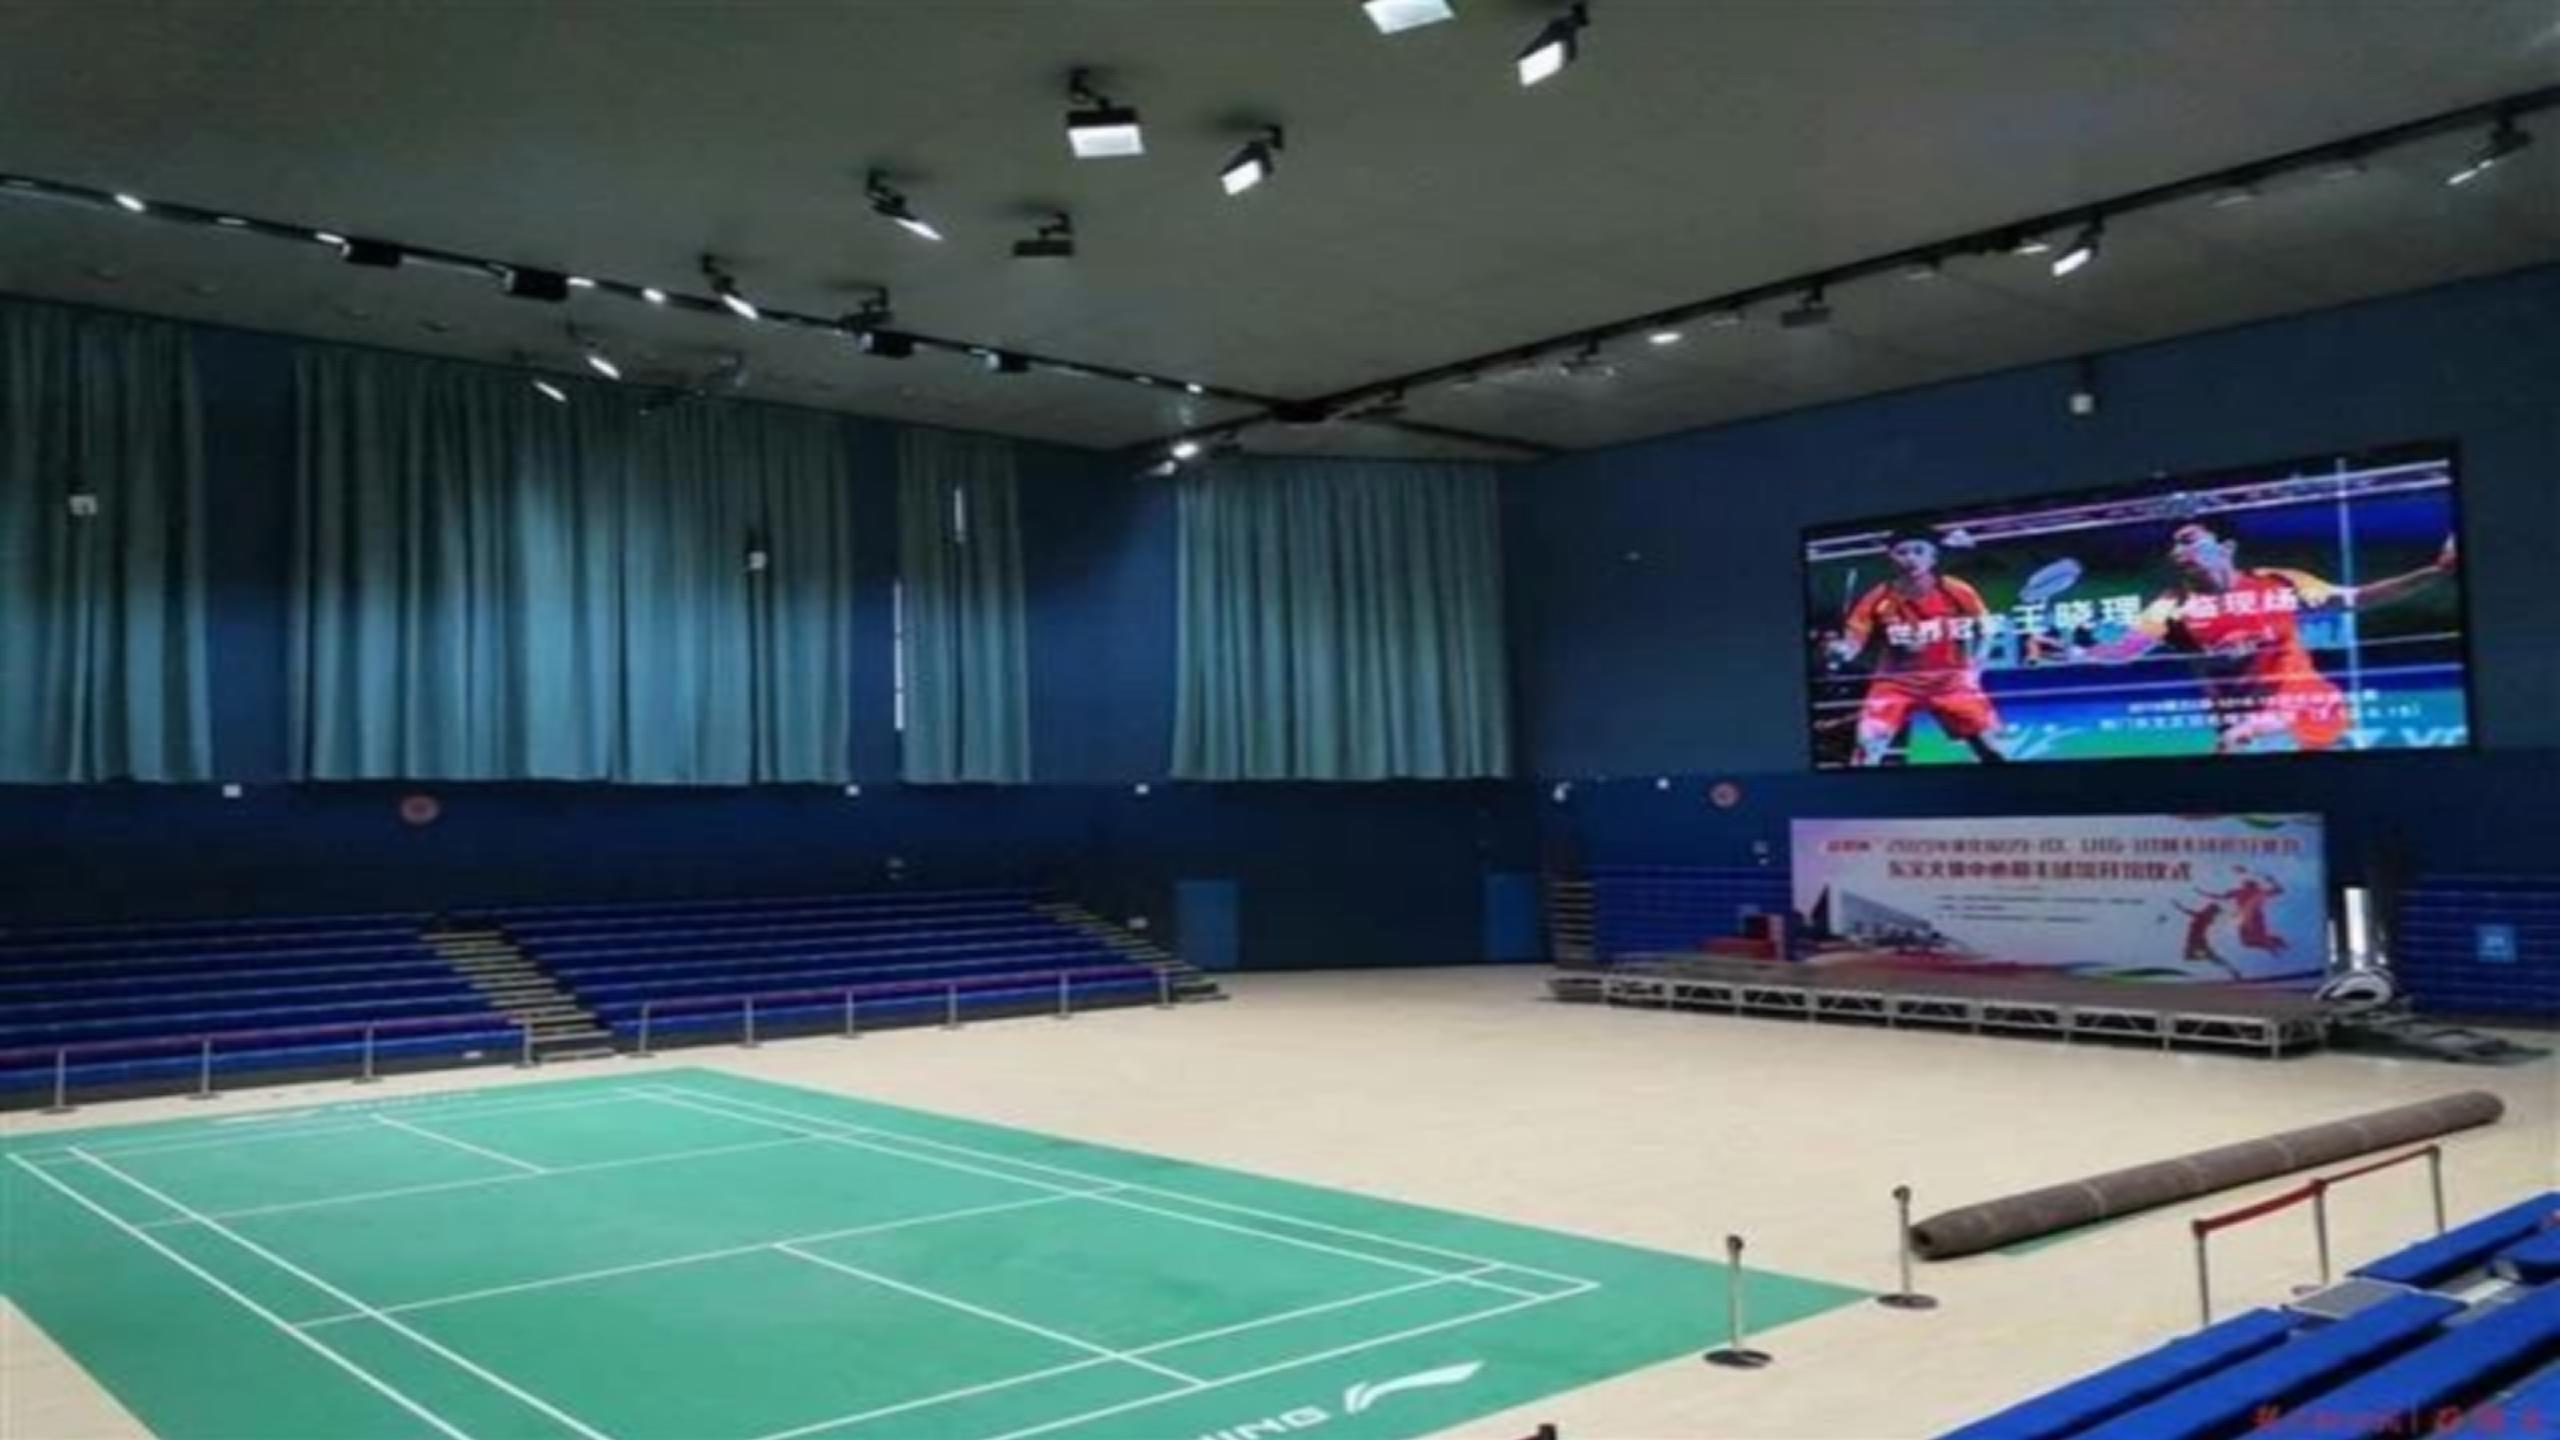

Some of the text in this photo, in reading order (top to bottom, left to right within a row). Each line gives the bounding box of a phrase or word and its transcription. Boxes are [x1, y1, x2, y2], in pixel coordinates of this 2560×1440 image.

[1886, 586, 2298, 646] 世界冠王晓理临现场
